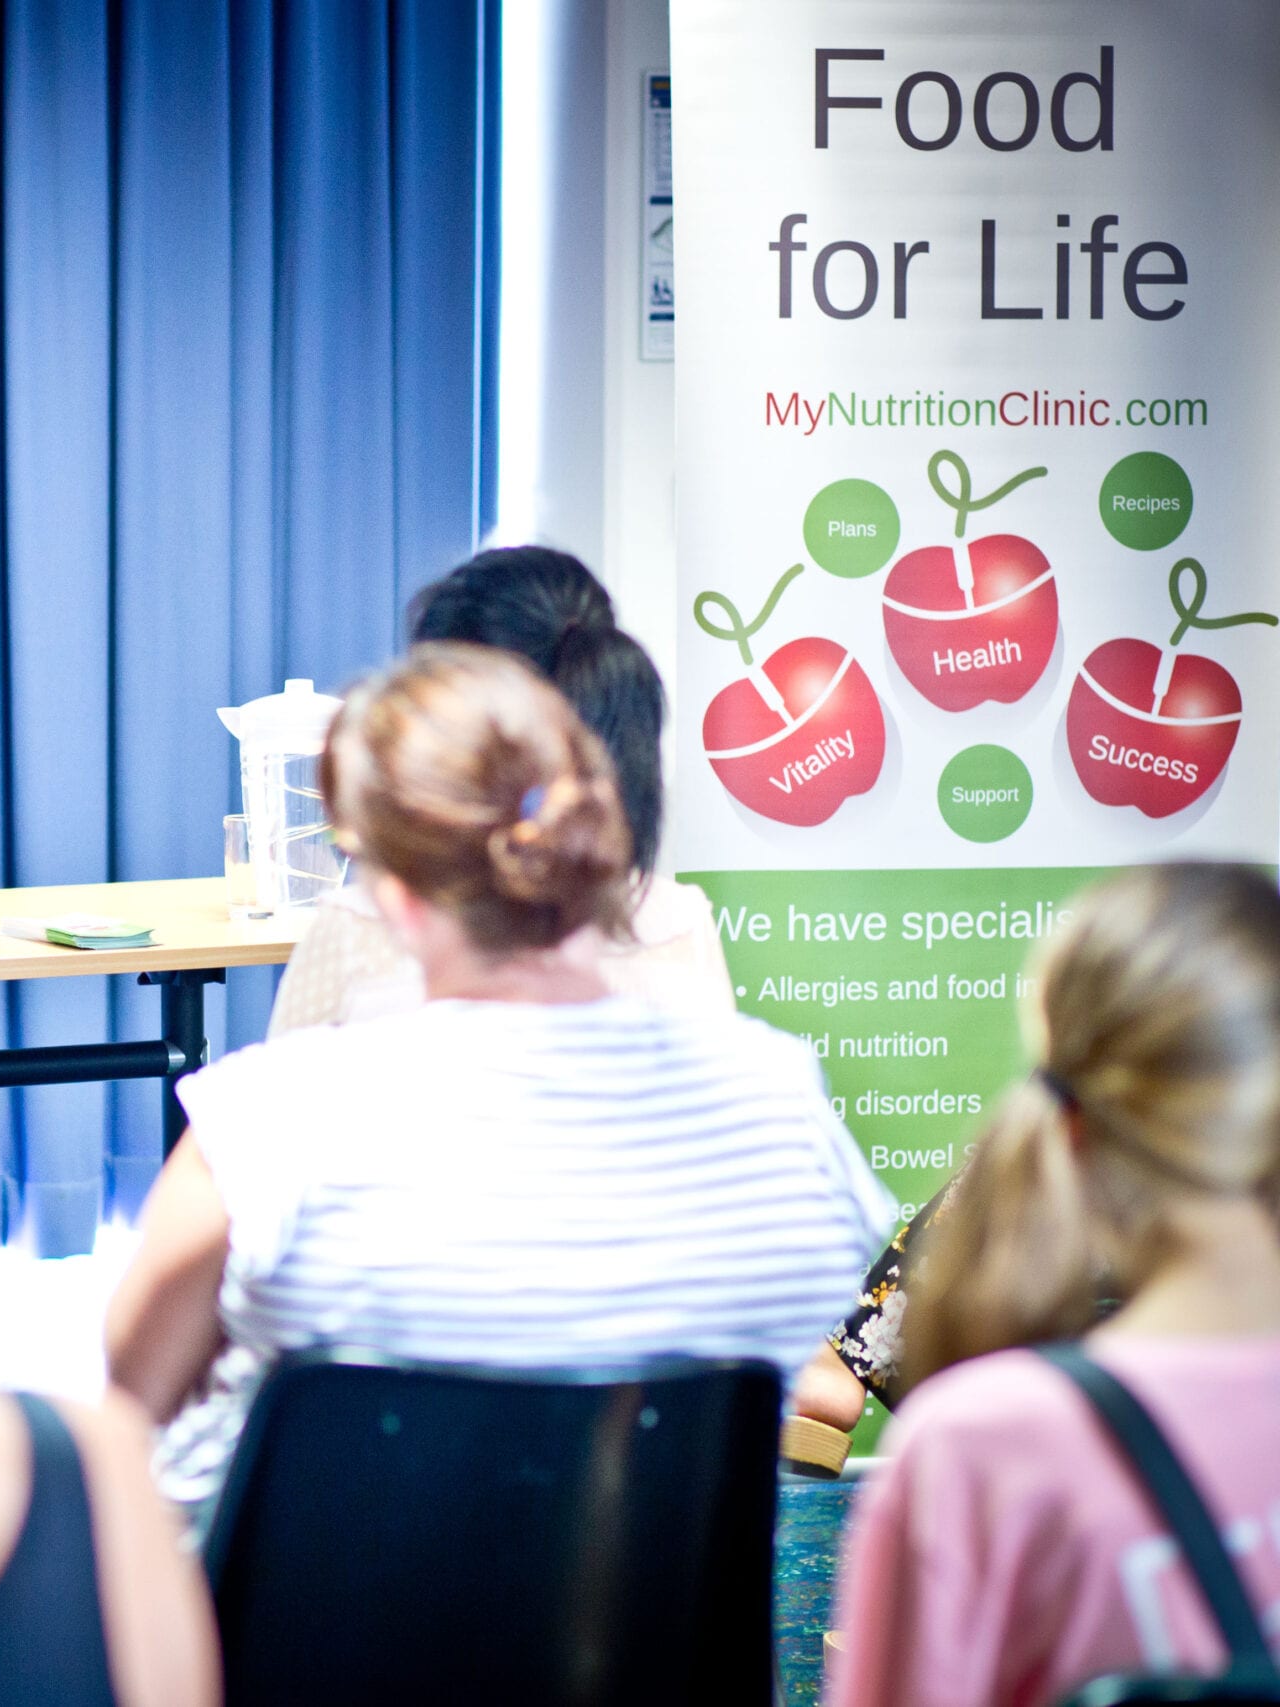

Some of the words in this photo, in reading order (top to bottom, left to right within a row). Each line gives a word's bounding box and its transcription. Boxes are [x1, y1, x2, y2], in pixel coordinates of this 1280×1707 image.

[814, 45, 1115, 152] Food
[768, 213, 930, 320] for
[980, 214, 1189, 322] Life
[765, 391, 1208, 435] MyNutritionClinic.com
[1113, 495, 1180, 514] Recipes
[827, 519, 877, 538] Plans
[933, 638, 1022, 676] Health
[768, 729, 855, 794] Vitality
[1088, 734, 1198, 784] Success
[951, 785, 1020, 806] Support
[716, 906, 772, 942] We
[788, 904, 887, 942] have
[901, 901, 1075, 950] specialis
[758, 975, 878, 1008] Allergies
[887, 974, 938, 1000] and
[947, 973, 1006, 1000] food
[839, 1031, 948, 1057] nutrition
[856, 1089, 982, 1115] disorders
[871, 1143, 953, 1169] Bowel
